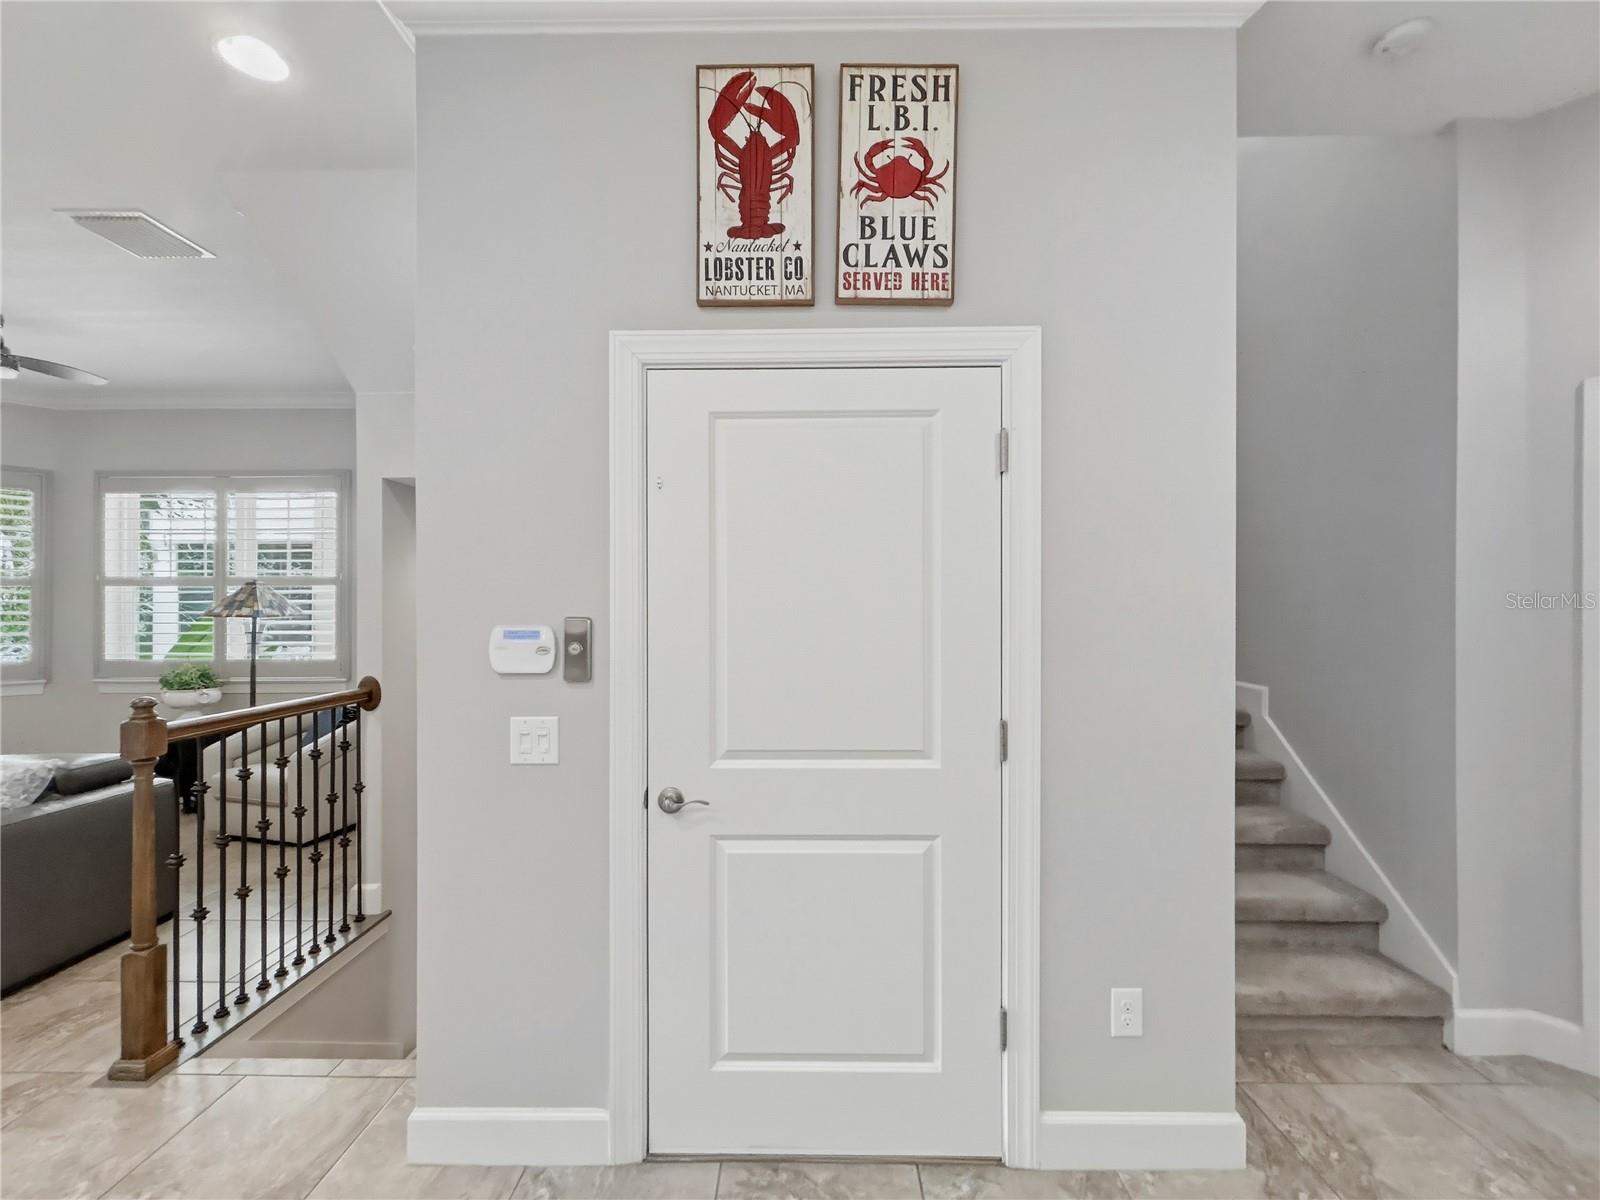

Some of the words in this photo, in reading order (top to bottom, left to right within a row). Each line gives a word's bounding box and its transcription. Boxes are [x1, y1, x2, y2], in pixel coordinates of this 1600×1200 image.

[848, 74, 951, 102] FRESH
[867, 105, 939, 131] L.B.I.
[859, 216, 937, 241] BLUE
[715, 238, 787, 254] Nantucket
[843, 244, 949, 269] CLAWS
[704, 257, 775, 282] LOBSTER
[842, 272, 903, 291] SERVED
[911, 272, 950, 291] HERE
[785, 285, 805, 296] MA
